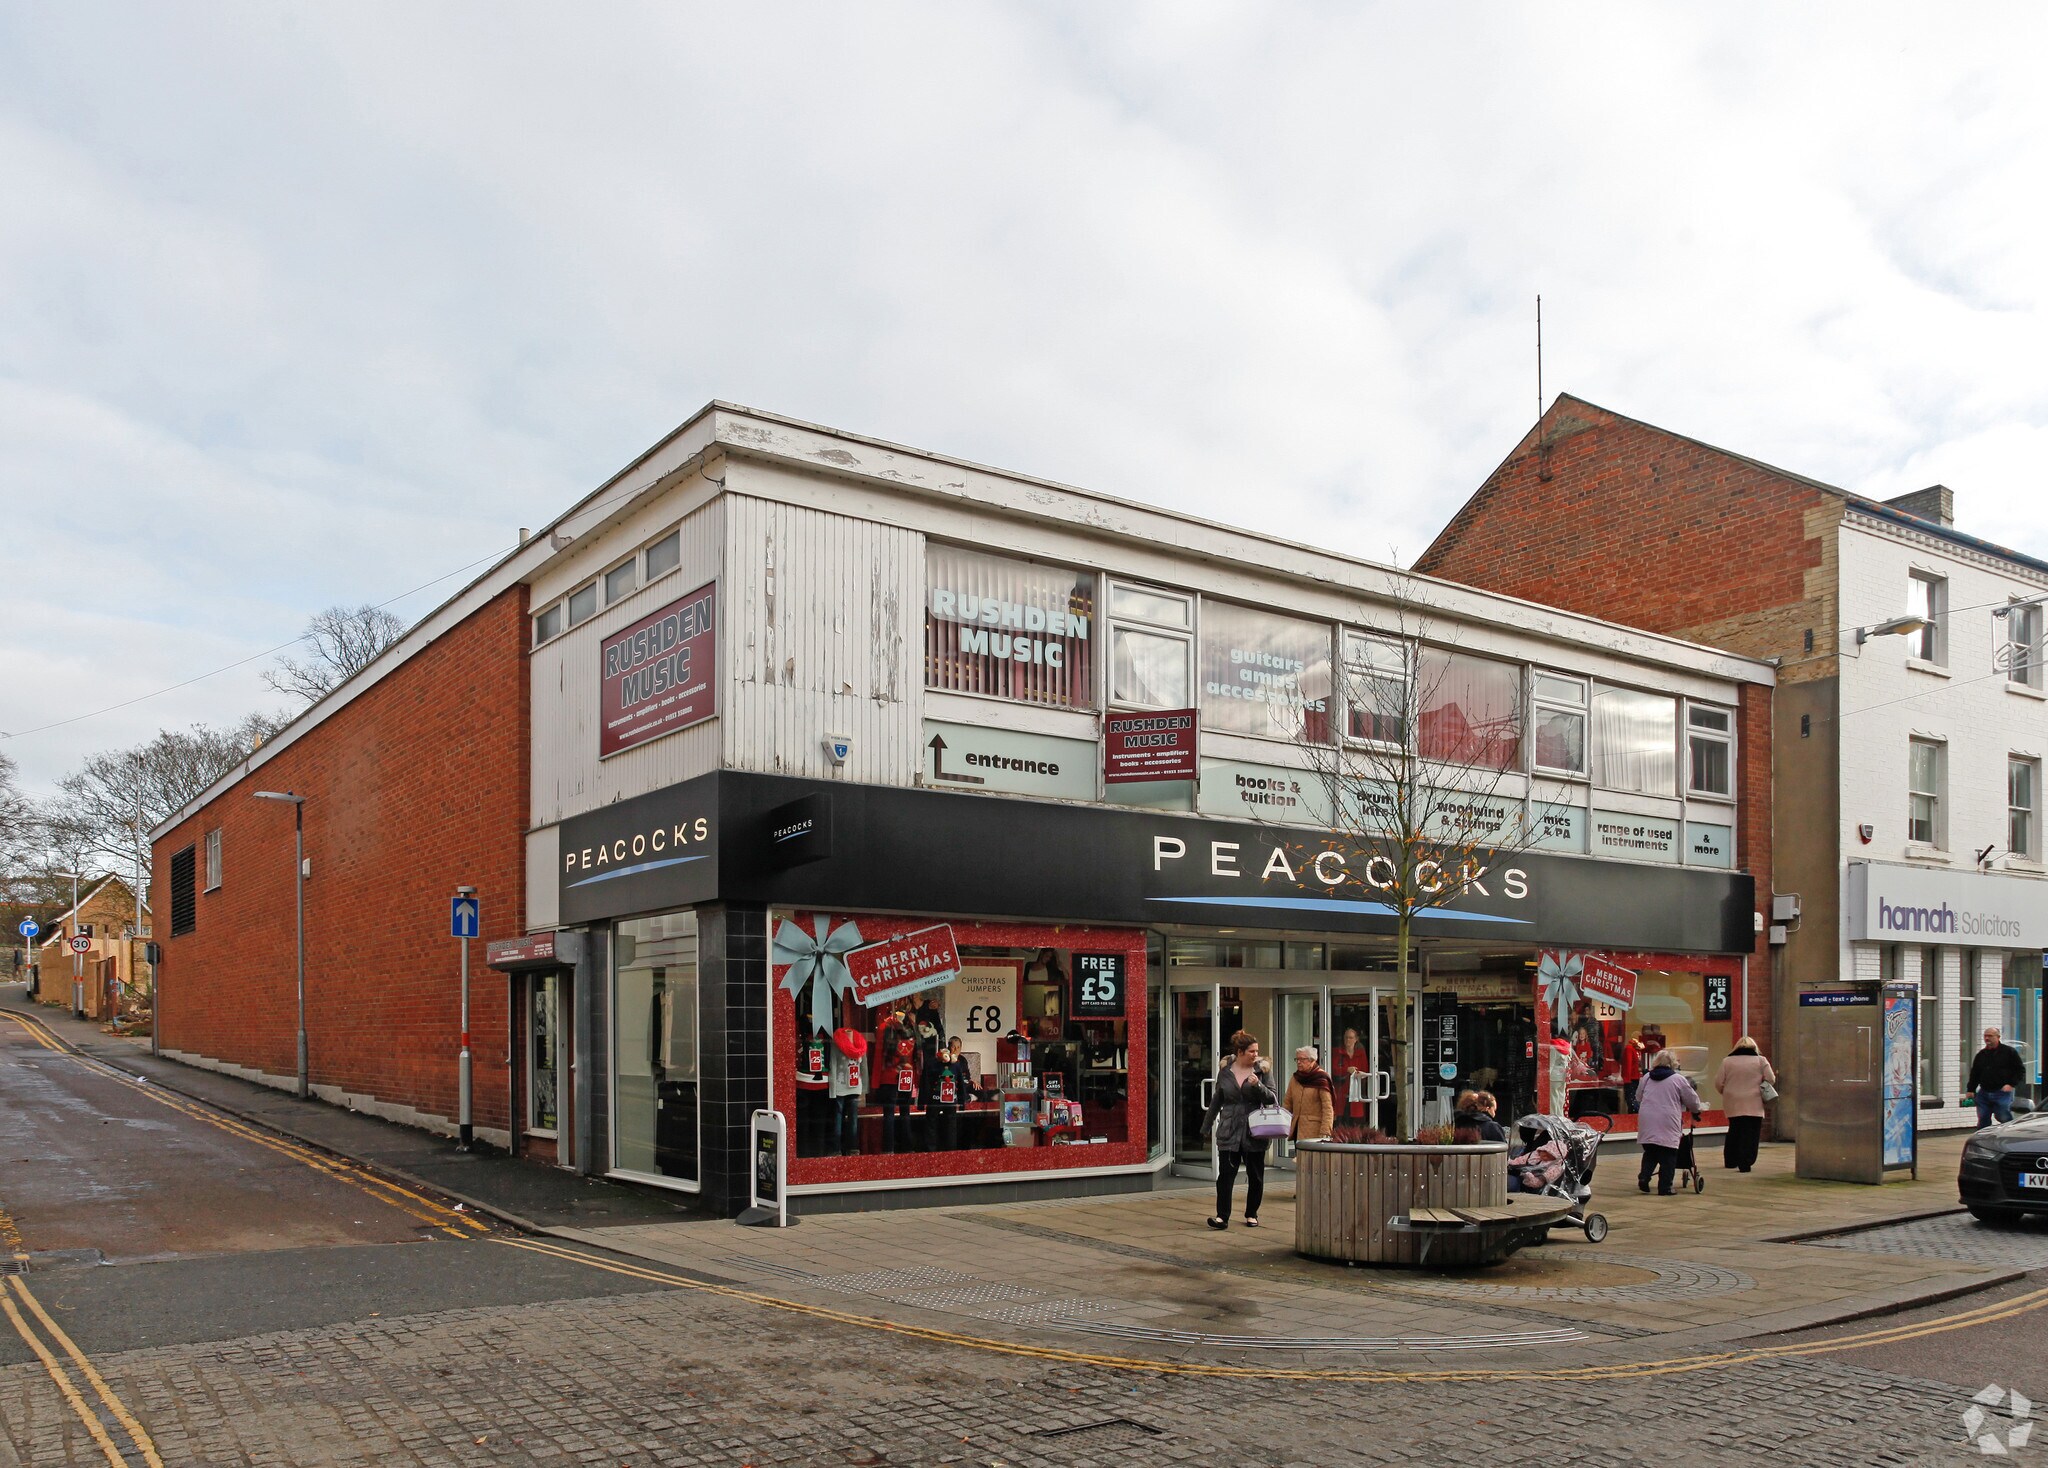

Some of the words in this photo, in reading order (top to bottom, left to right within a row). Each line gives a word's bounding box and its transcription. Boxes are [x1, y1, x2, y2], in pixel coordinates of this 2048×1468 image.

[933, 588, 1087, 640] RUSHDEN
[604, 594, 712, 680] RUSHDEN
[960, 627, 1063, 668] MUSIC
[1230, 648, 1304, 673] guitars
[621, 647, 691, 709] MUSIC
[1239, 666, 1297, 690] amps
[1206, 679, 1326, 713] accessories
[1109, 715, 1192, 735] RUSHDEN
[1123, 732, 1178, 749] MUSIC
[965, 752, 1060, 776] entrance
[1112, 752, 1151, 760] instruments
[1144, 758, 1181, 766] accessories
[1235, 774, 1285, 792] books
[1289, 781, 1301, 794] &
[1240, 789, 1297, 807] tuition
[1437, 802, 1505, 819] woodwind
[774, 819, 813, 838] PEACOCKS
[1441, 815, 1450, 826] &
[1455, 817, 1501, 832] strings
[1543, 814, 1571, 827] mics
[1555, 828, 1571, 839] PA
[1597, 822, 1630, 836] range
[1633, 826, 1645, 837] of
[1648, 828, 1673, 840] used
[1703, 834, 1710, 844] &
[566, 817, 708, 873] PEACOCKS
[1602, 834, 1668, 851] instruments
[1694, 845, 1719, 856] more
[1153, 835, 1528, 899] PEACOCKS
[1879, 896, 1954, 933] hannah
[1962, 912, 2020, 938] Solicitors
[73, 940, 89, 948] 30
[875, 943, 929, 970] MERRY
[1081, 957, 1115, 969] FREE
[860, 951, 951, 988] CHRISTMAS
[1596, 969, 1623, 985] MERRY
[924, 974, 950, 986] PEACOCKS
[961, 977, 1006, 985] CHRISTMAS
[966, 985, 1002, 993] JUMPERS
[1081, 970, 1116, 1001] £5
[1446, 977, 1477, 985] MERRY
[1585, 974, 1631, 998] CHRISTMAS
[1708, 978, 1726, 987] FREE
[1708, 987, 1727, 1009] £5
[1850, 995, 1869, 1003] phone
[966, 1005, 1002, 1033] £8
